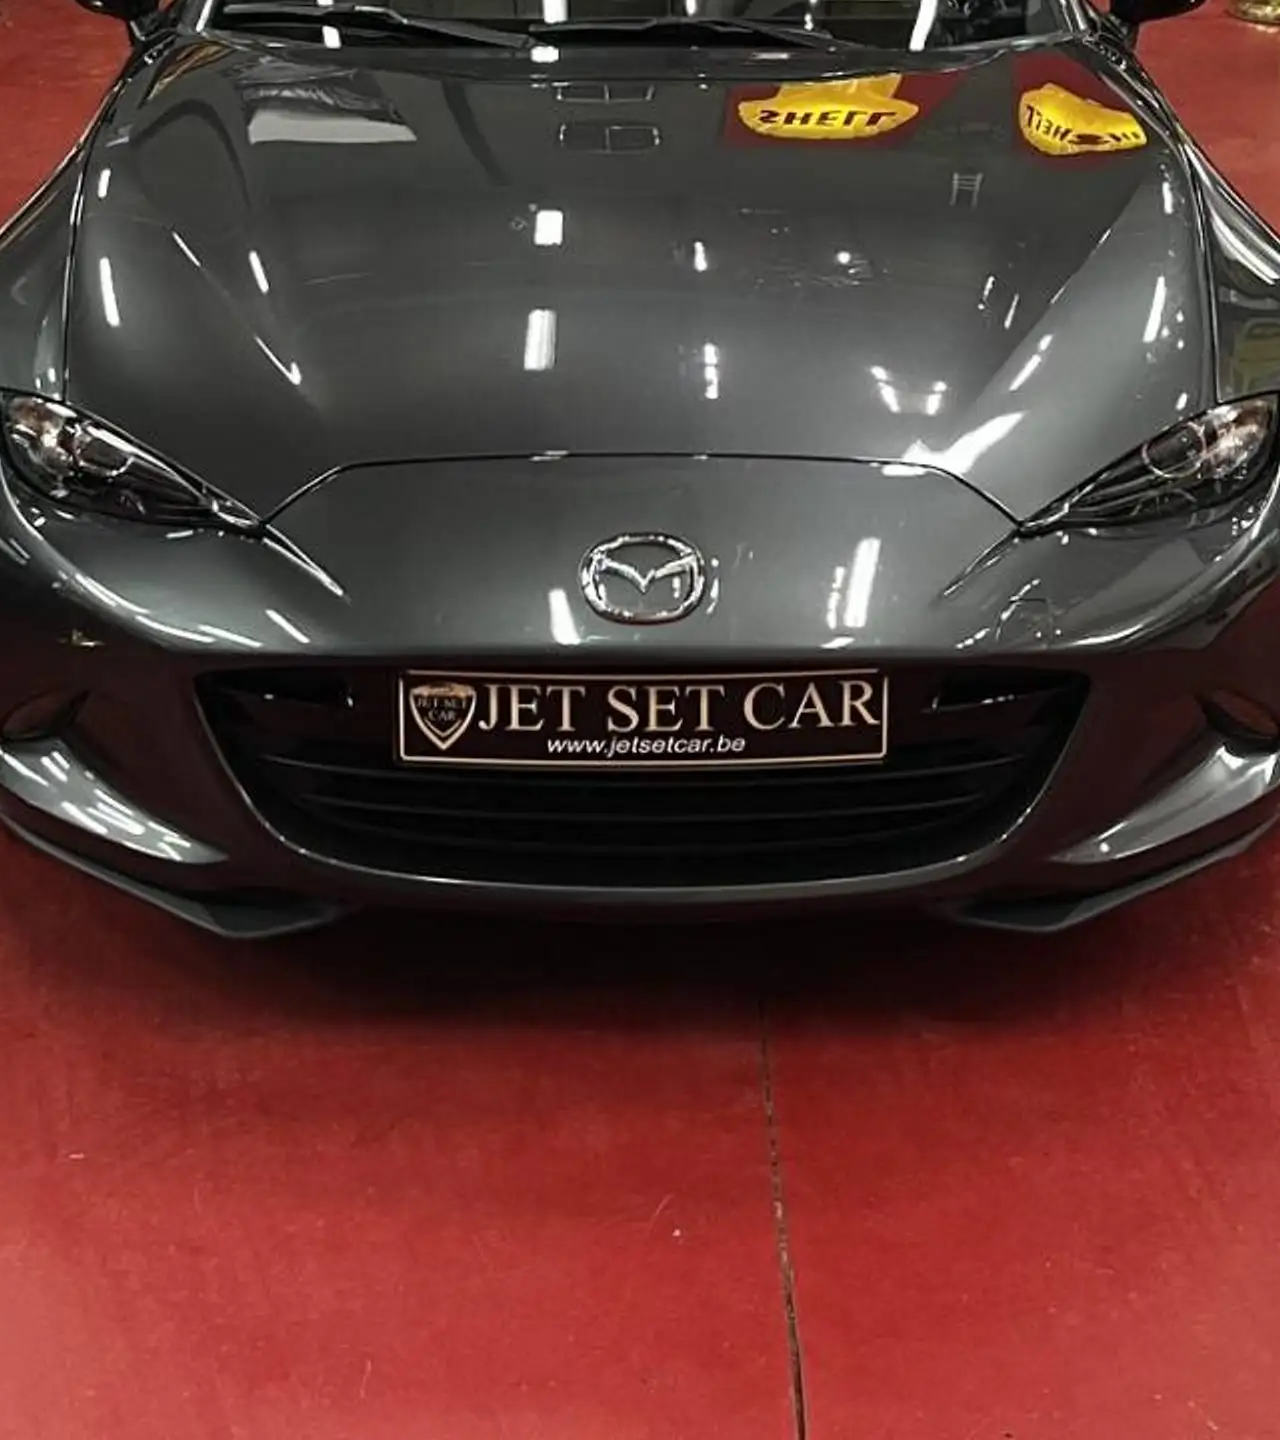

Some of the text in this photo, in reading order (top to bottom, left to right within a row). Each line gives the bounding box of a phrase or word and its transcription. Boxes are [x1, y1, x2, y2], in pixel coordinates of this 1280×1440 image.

[478, 679, 881, 733] JET SET CAR
[546, 735, 746, 758] www.jetsetcar.be
